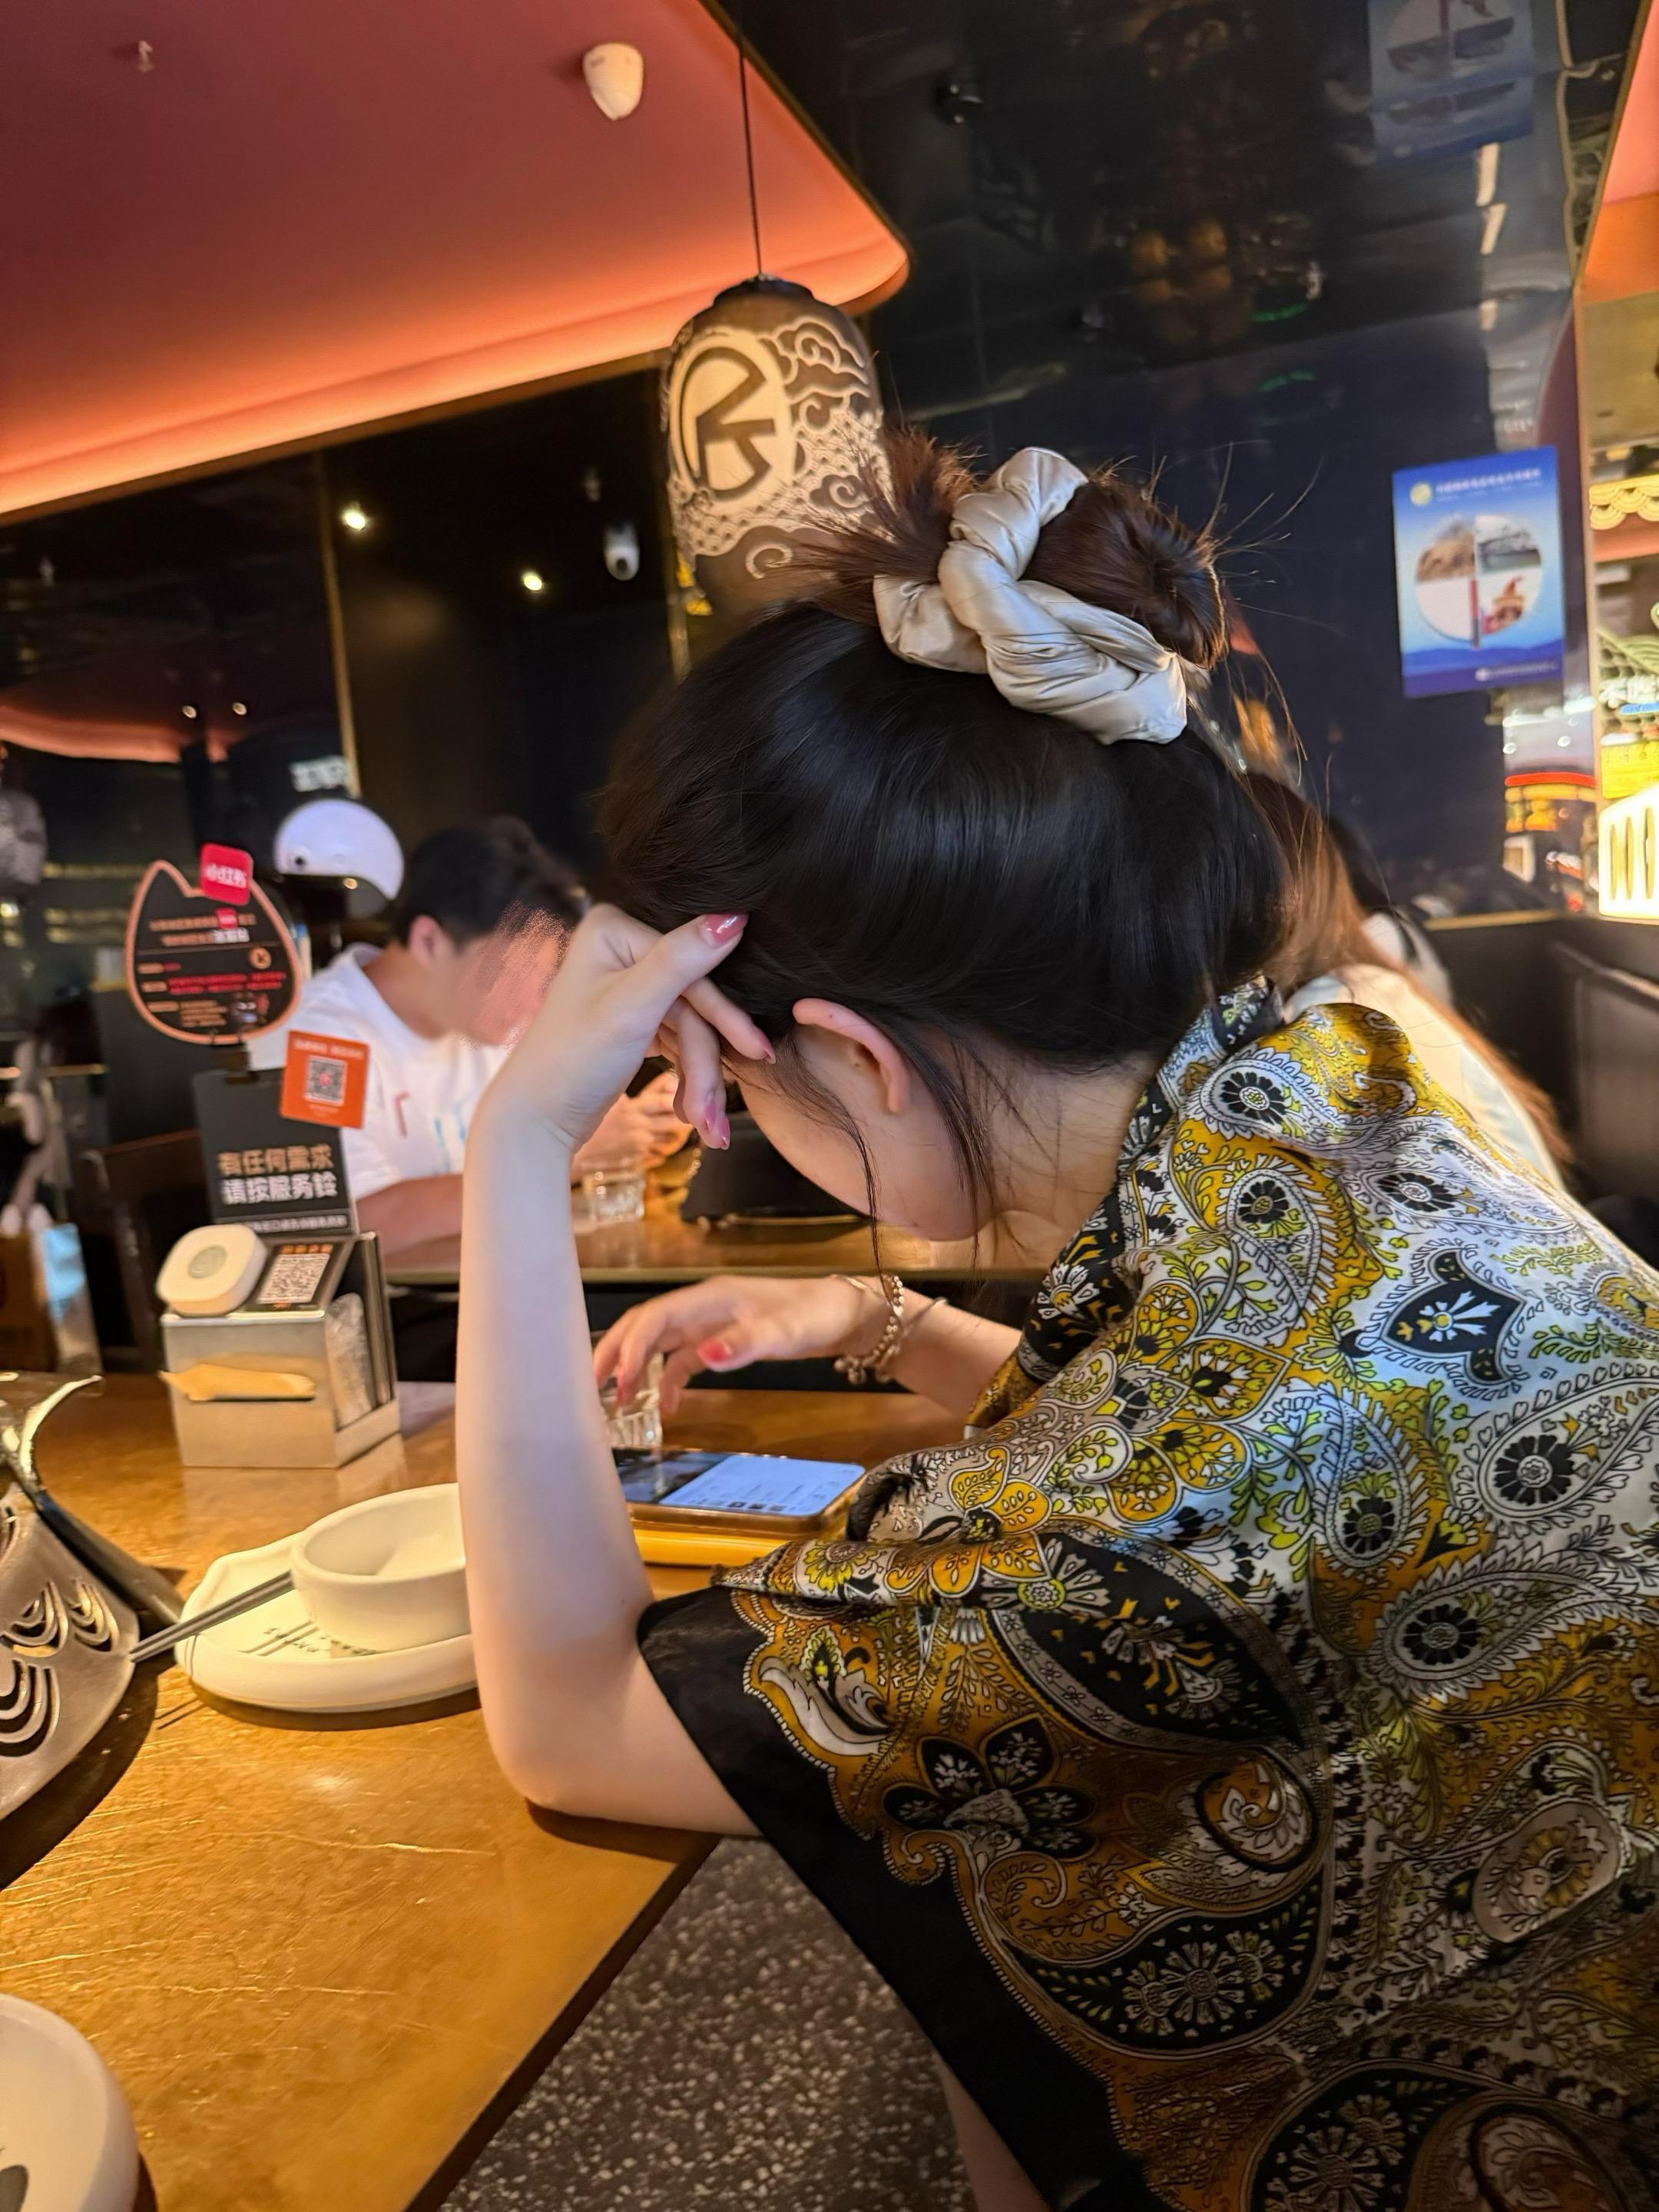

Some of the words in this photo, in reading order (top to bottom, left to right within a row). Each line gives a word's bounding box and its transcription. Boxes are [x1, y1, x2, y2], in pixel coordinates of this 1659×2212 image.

[222, 1171, 337, 1204] 请按服务铃
